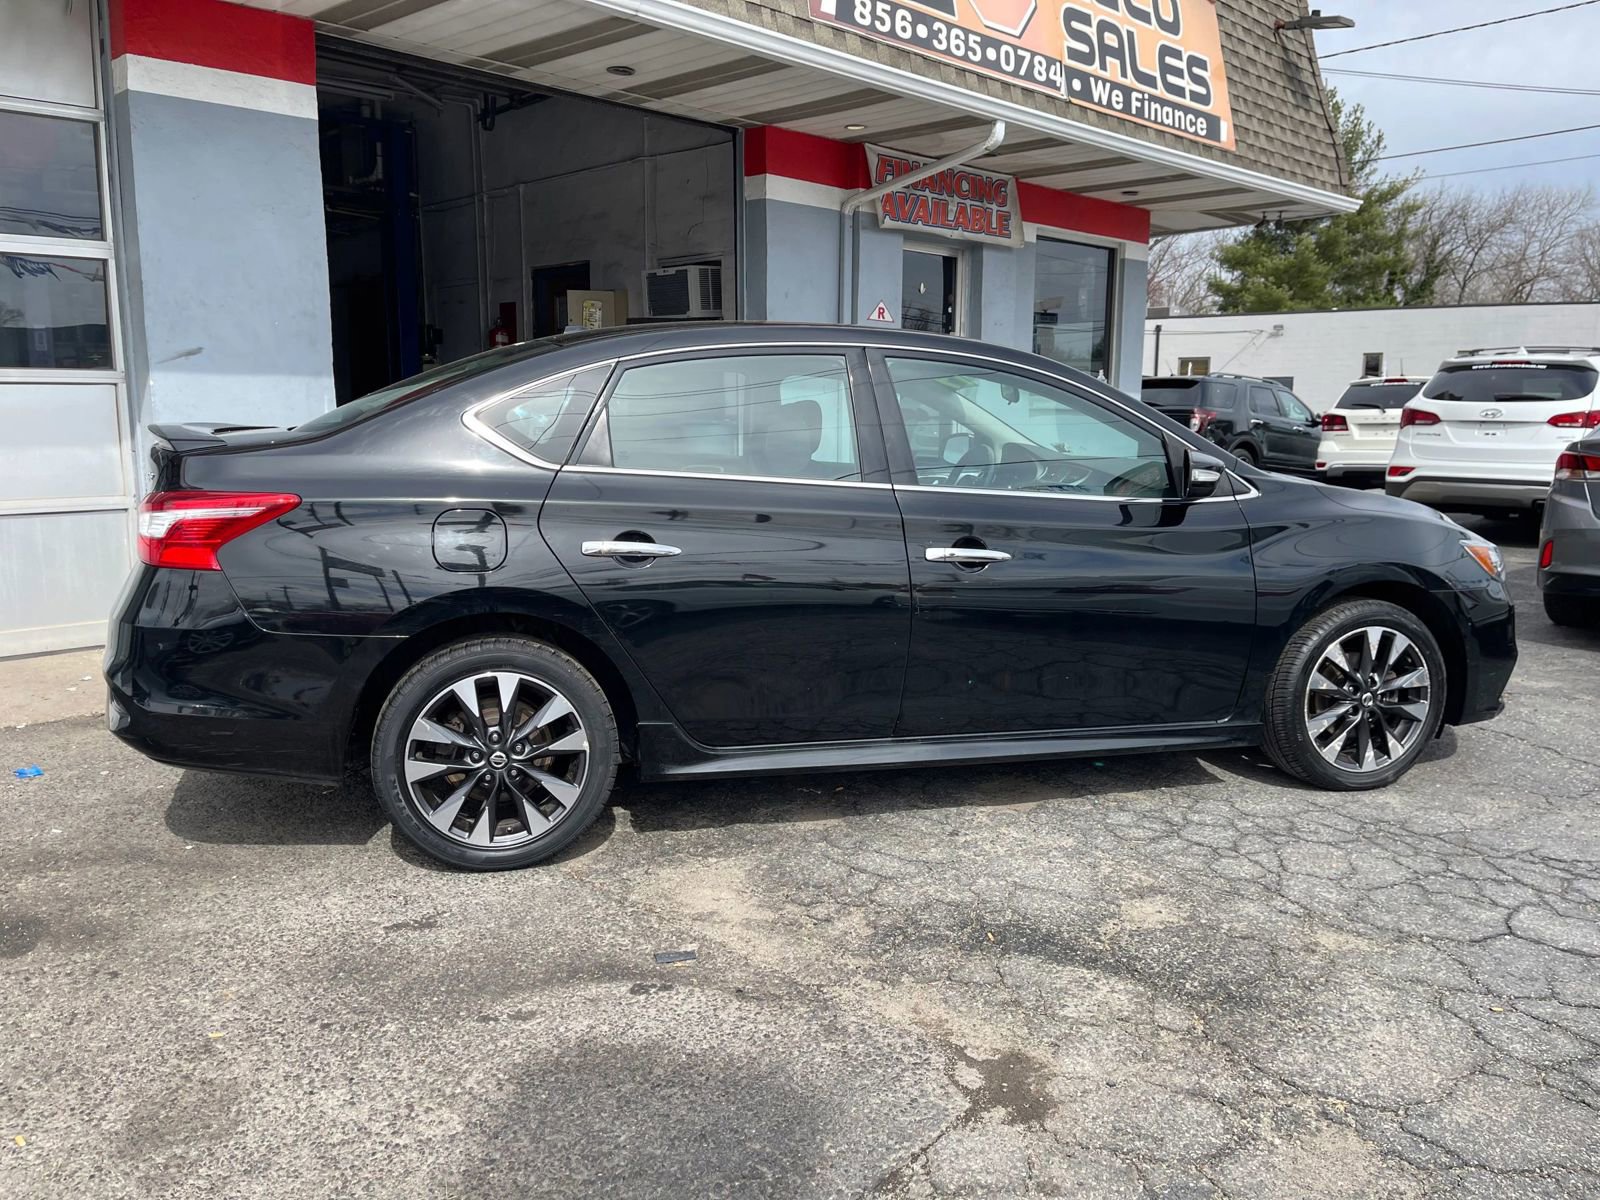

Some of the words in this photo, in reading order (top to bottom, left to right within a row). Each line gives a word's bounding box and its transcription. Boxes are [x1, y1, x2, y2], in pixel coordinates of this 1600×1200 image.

[1061, 5, 1212, 108] SALES
[1089, 77, 1124, 110] We
[1130, 91, 1208, 136] Finance
[880, 191, 1011, 238] AVAILABLE
[878, 306, 886, 320] R
